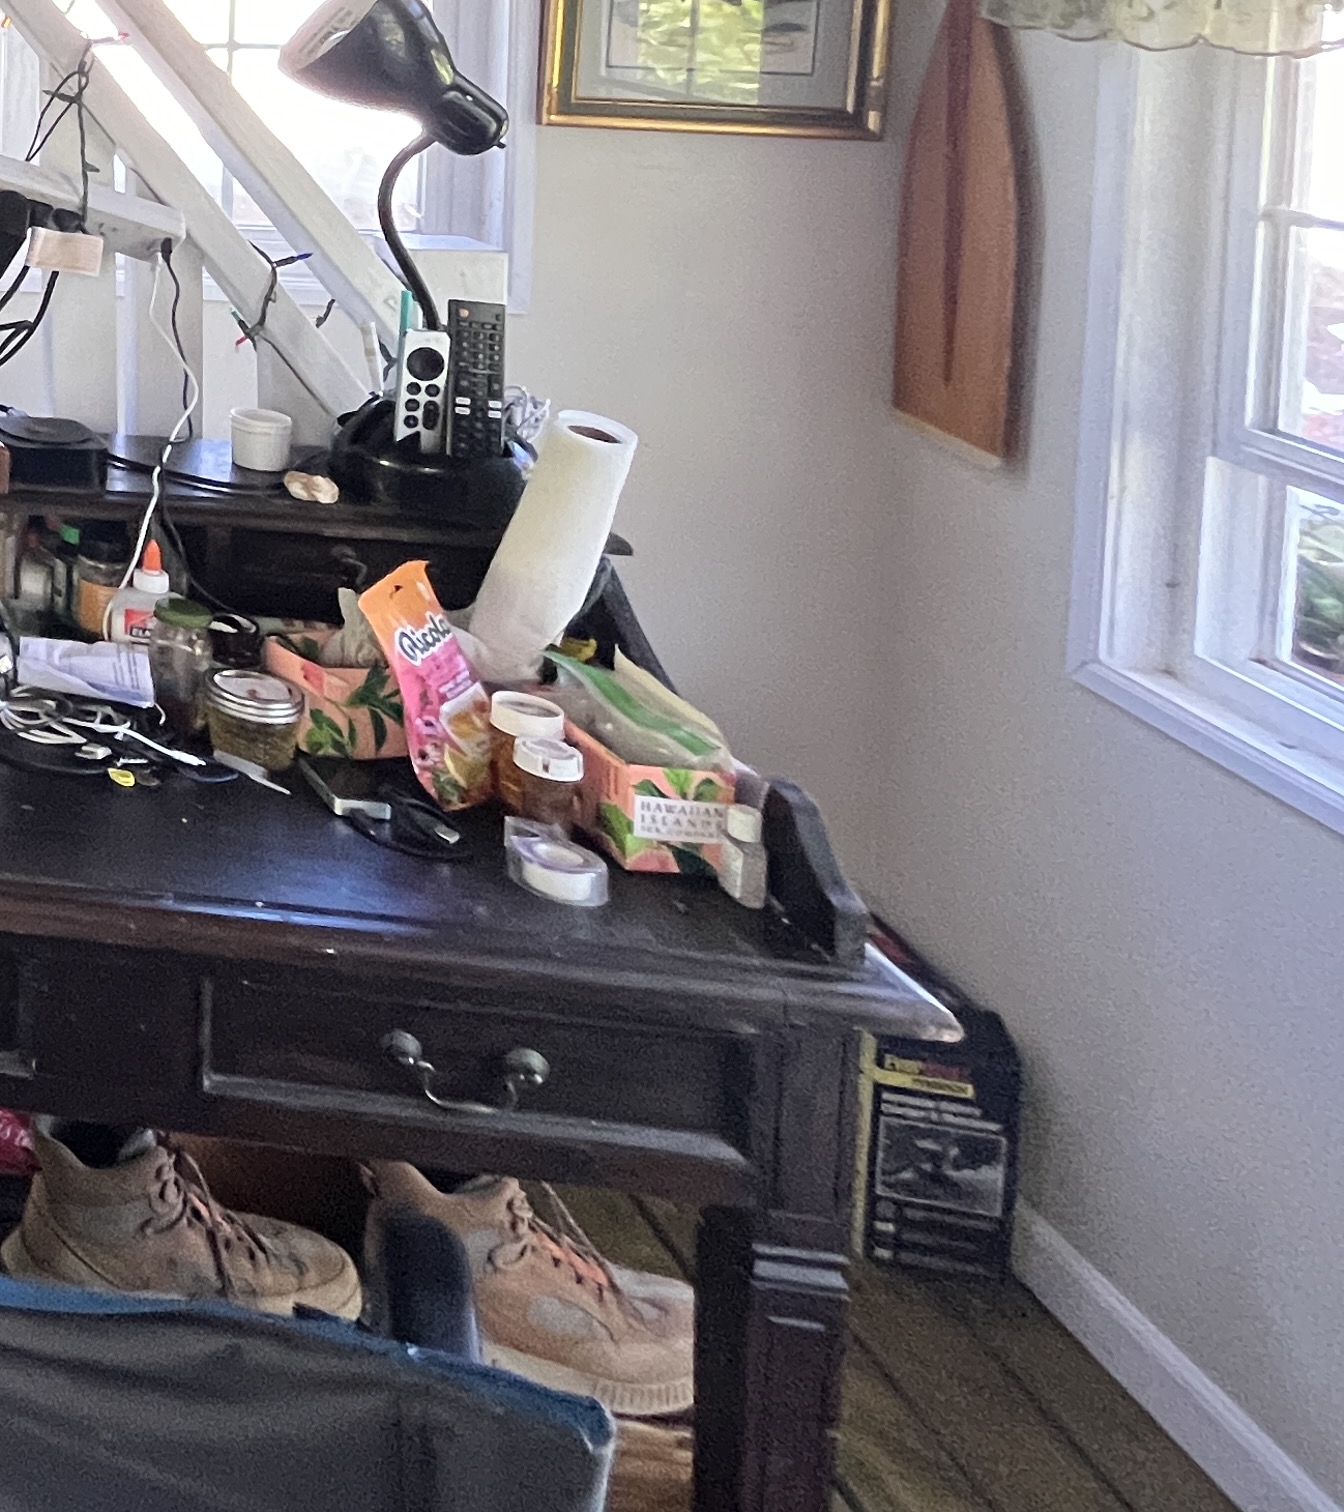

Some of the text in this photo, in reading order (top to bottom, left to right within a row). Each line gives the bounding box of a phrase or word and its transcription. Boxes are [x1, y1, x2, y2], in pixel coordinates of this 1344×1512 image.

[398, 615, 451, 662] Ricola
[641, 801, 723, 818] HAWAIIAN
[640, 813, 722, 830] ISLANDS
